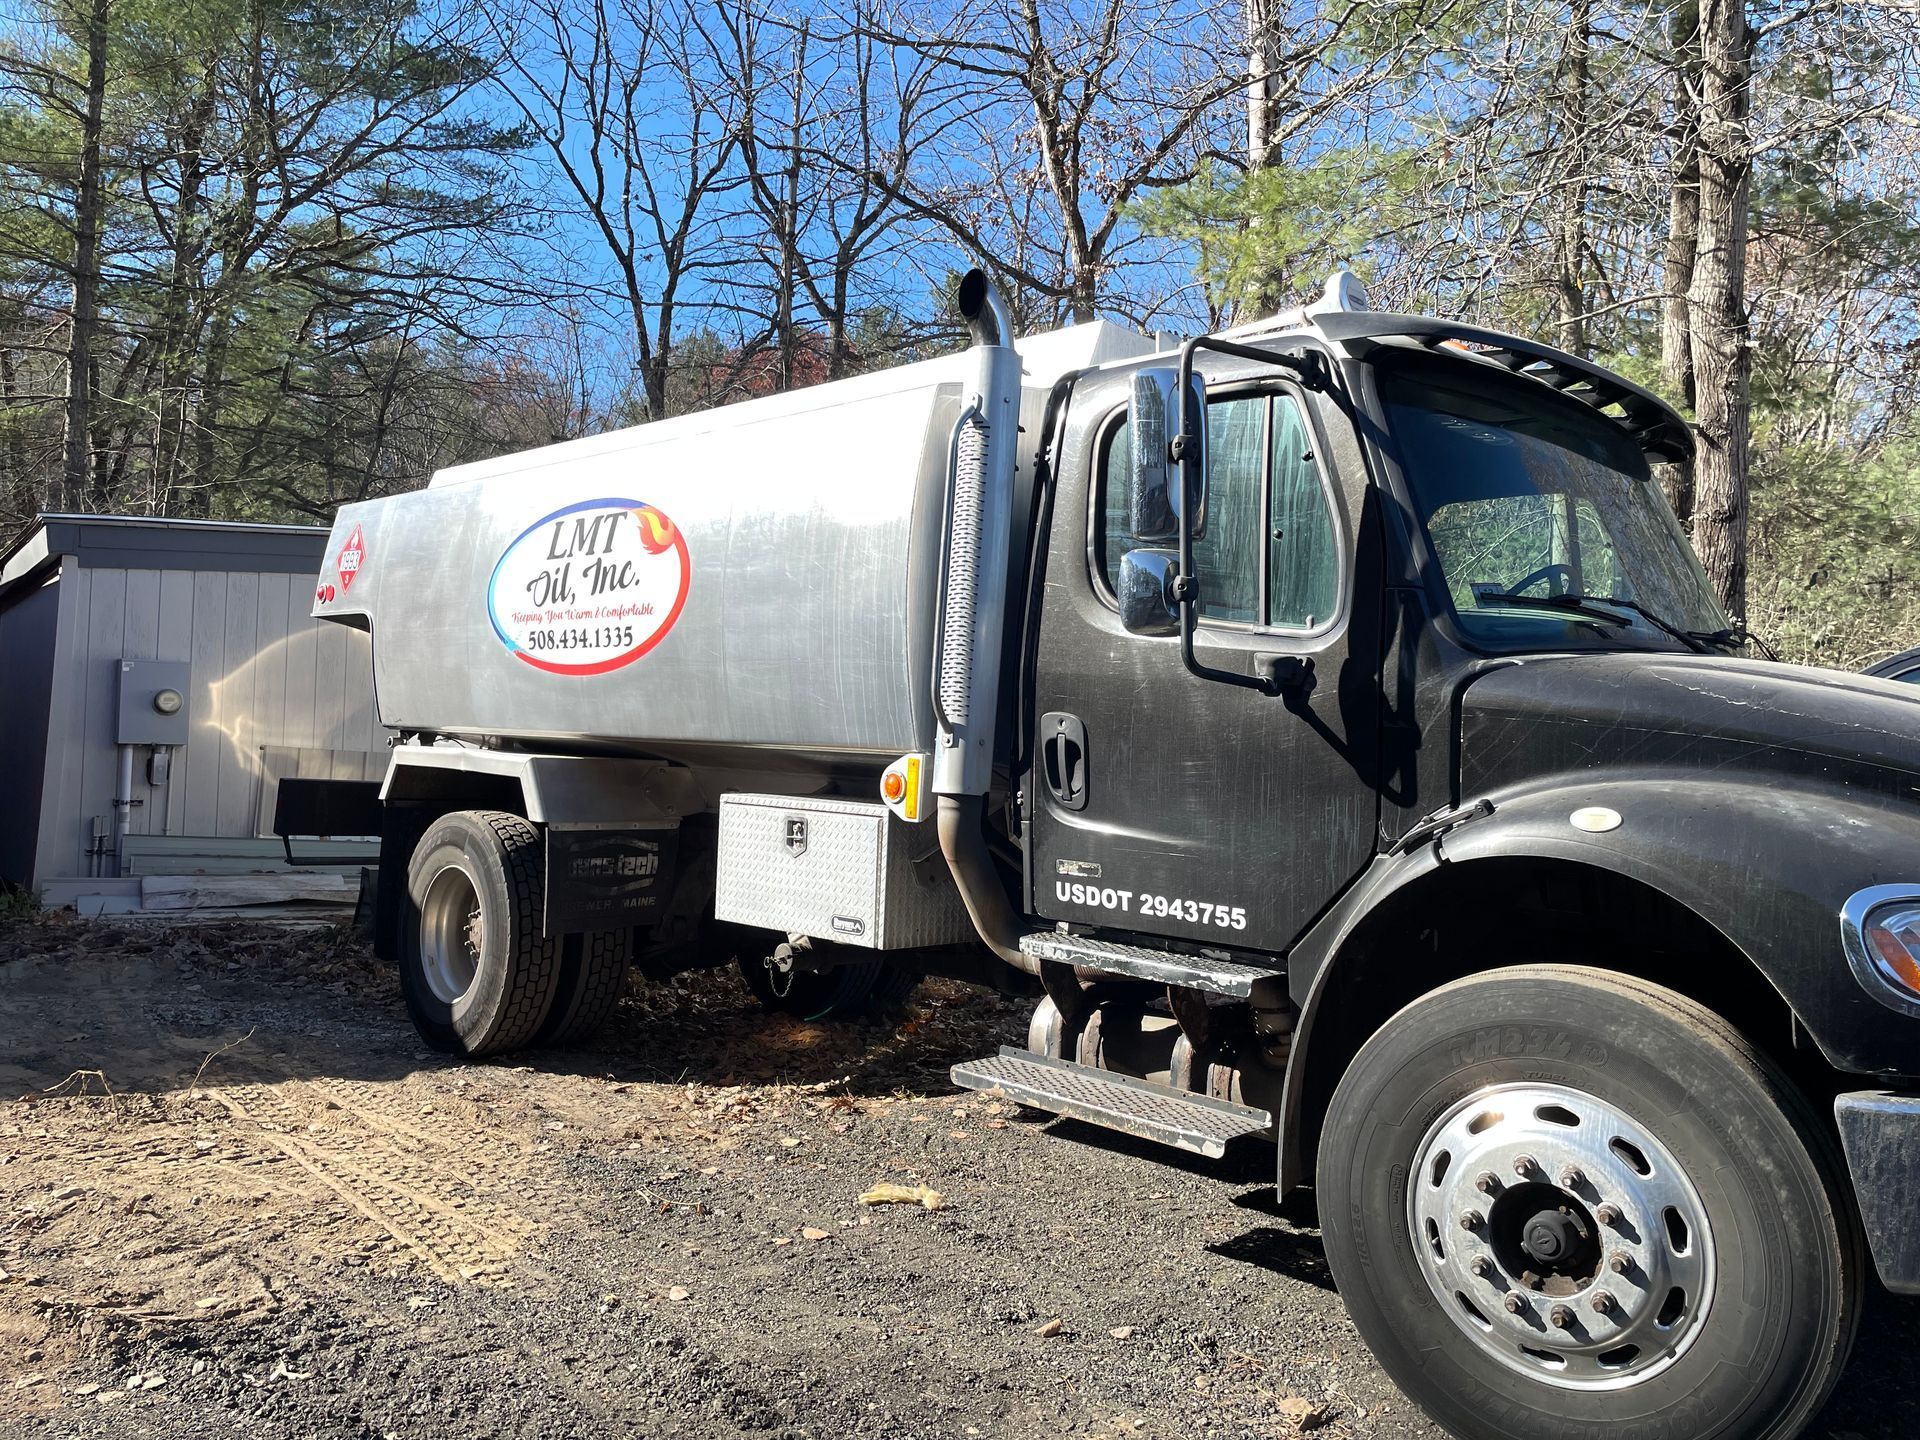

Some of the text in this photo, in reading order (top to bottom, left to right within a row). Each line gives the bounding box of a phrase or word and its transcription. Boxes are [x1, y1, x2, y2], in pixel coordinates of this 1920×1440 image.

[546, 511, 628, 560] LMT
[526, 557, 640, 607] Oil, Inc.
[512, 611, 543, 625] Keeping
[545, 609, 564, 624] You
[565, 609, 593, 620] Warm
[601, 602, 654, 620] Comfortable
[528, 625, 633, 650] 508.434.1335
[622, 896, 657, 909] MAINE
[1055, 881, 1247, 931] USDOT 2943755
